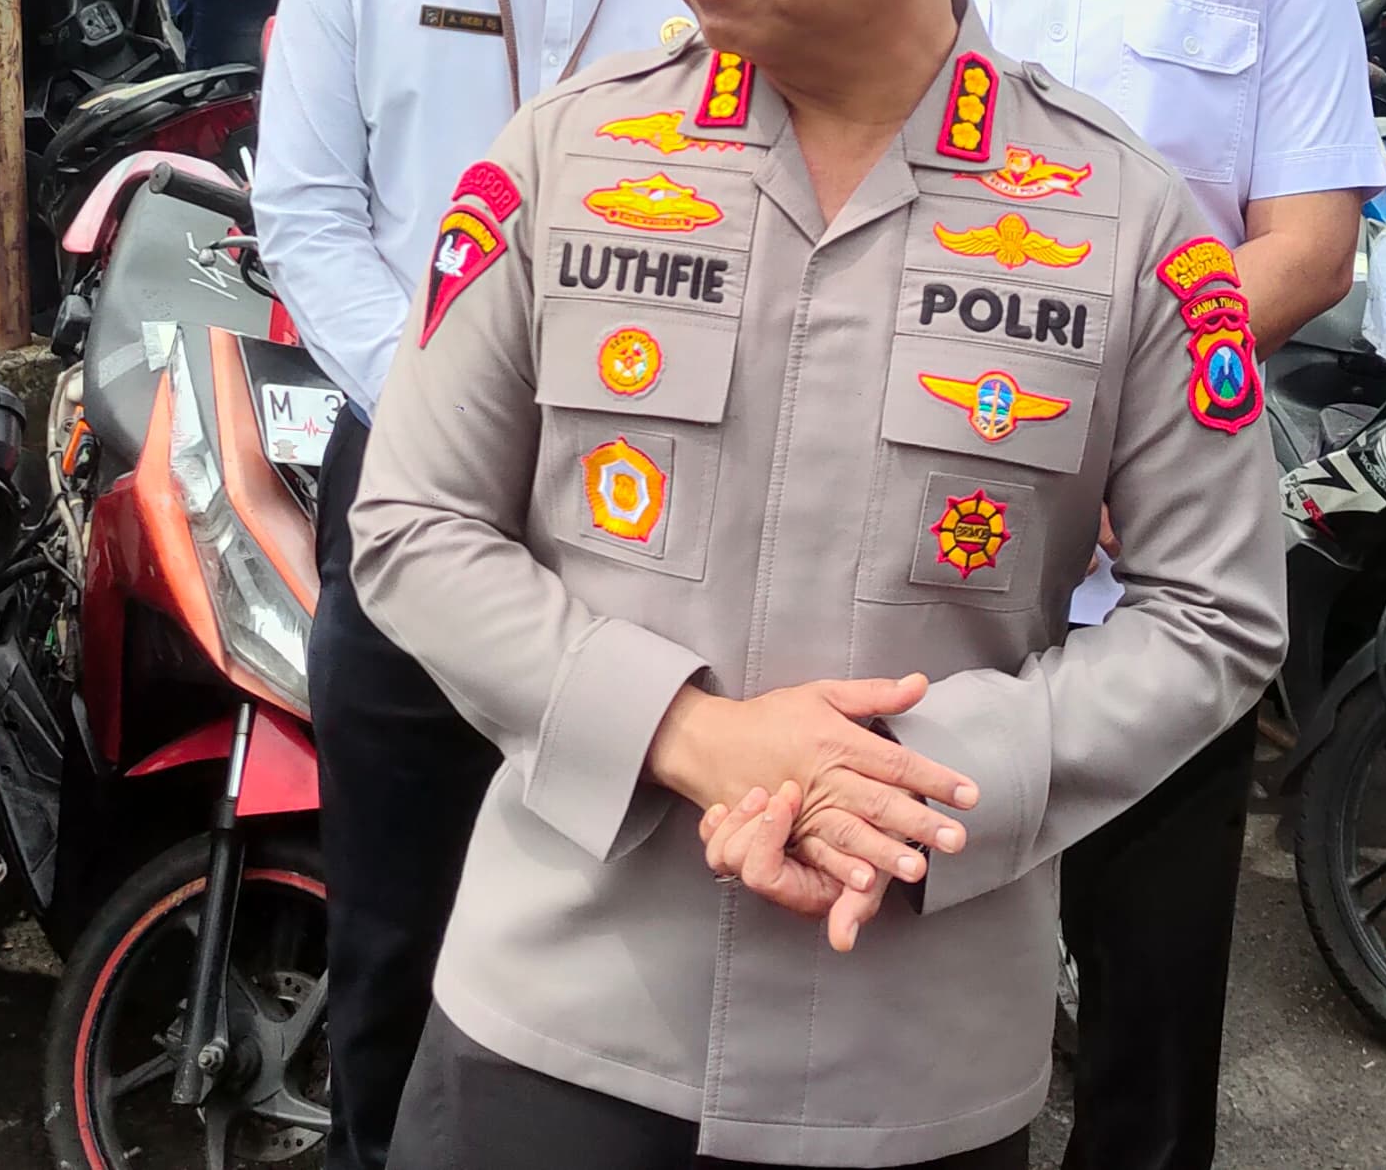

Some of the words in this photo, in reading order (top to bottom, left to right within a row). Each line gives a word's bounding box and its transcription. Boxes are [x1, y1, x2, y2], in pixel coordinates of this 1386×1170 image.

[559, 242, 729, 304] LUTHFIE
[920, 283, 1087, 349] POLRI
[1191, 297, 1219, 319] JAWA
[269, 390, 293, 422] M
